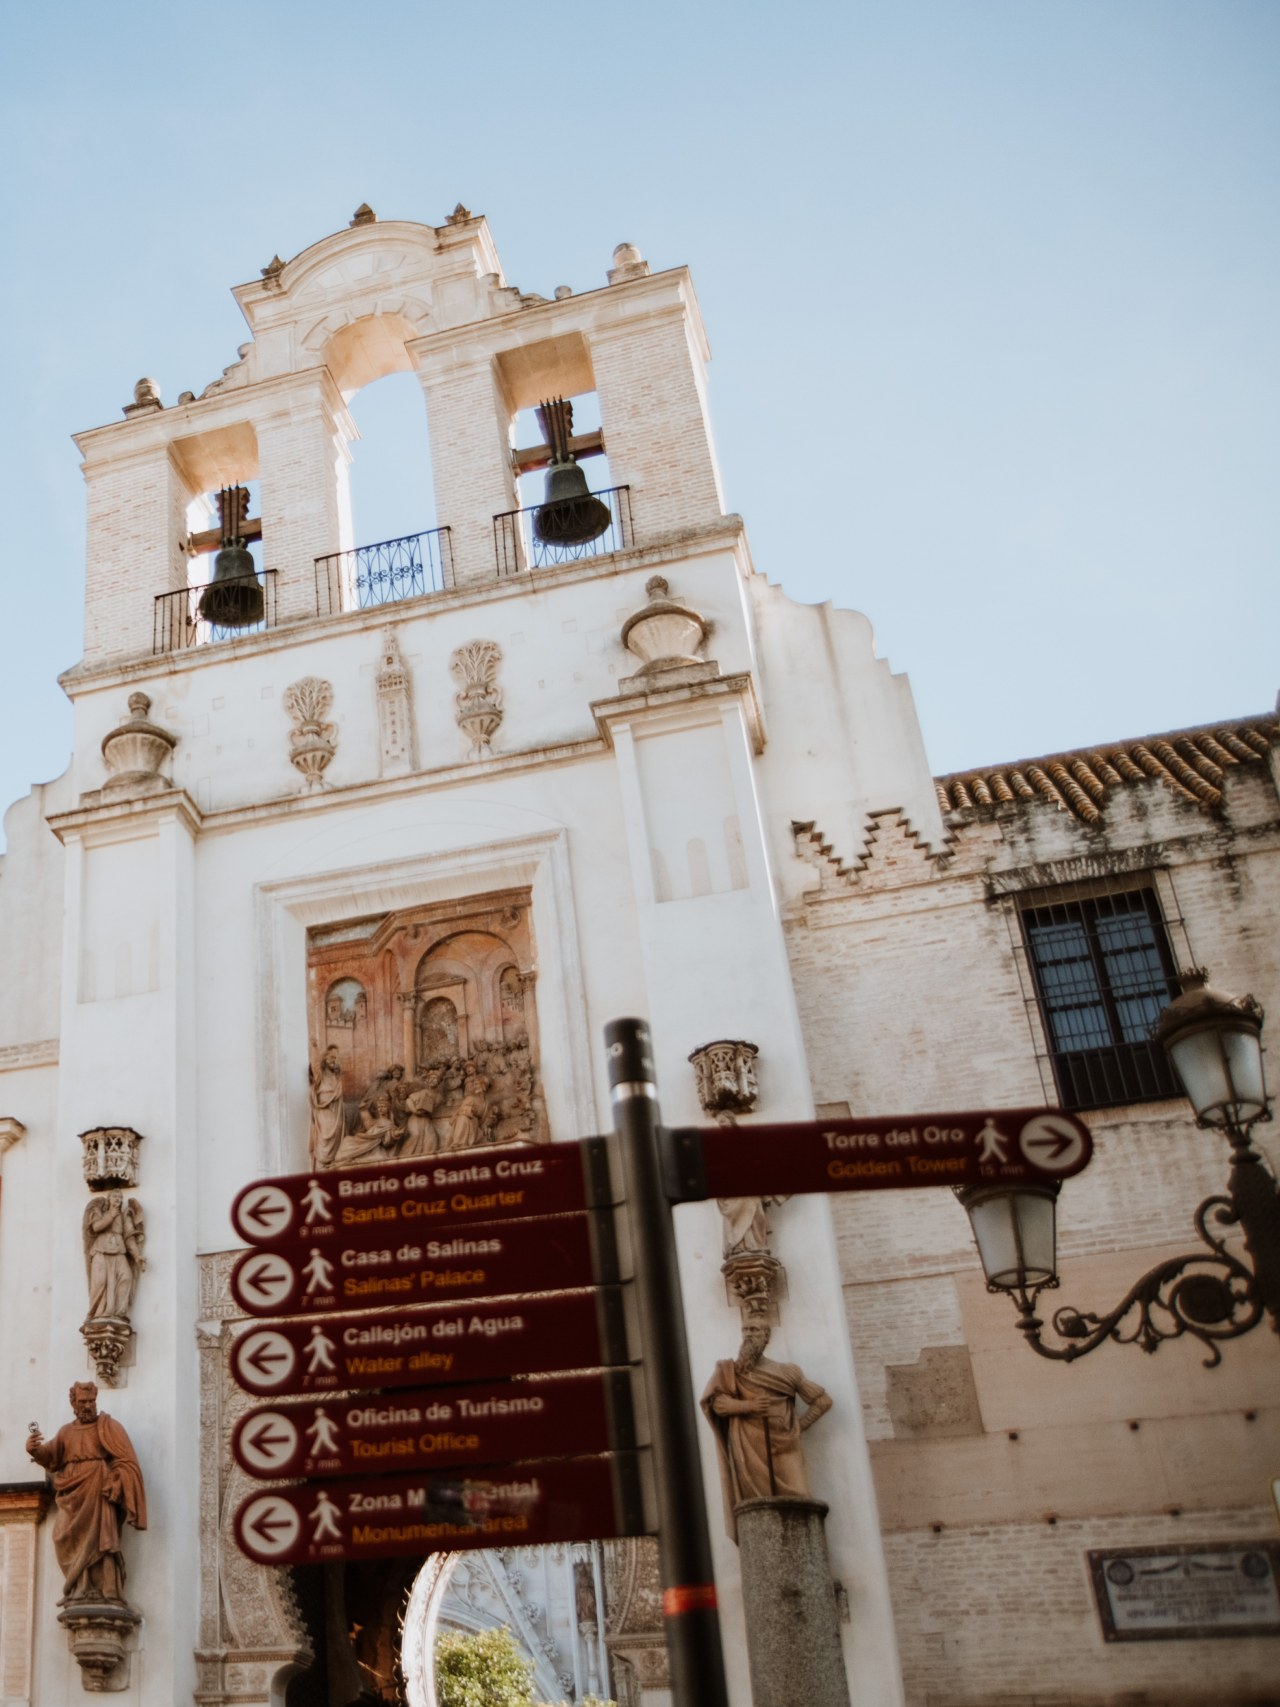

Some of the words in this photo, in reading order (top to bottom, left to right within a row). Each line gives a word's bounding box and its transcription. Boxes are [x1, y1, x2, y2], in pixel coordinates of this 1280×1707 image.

[824, 1130, 879, 1149] Torre
[885, 1127, 918, 1146] del
[923, 1126, 964, 1143] Oro
[827, 1159, 901, 1178] Golden
[906, 1155, 968, 1172] Tower
[1000, 1164, 1024, 1175] min
[338, 1174, 399, 1197] Barrio
[403, 1169, 428, 1188] de
[433, 1164, 491, 1185] Santa
[496, 1160, 543, 1178] Cruz
[342, 1204, 397, 1224] Santa
[401, 1198, 447, 1216] Cruz
[451, 1190, 524, 1211] Quarter
[313, 1224, 334, 1235] min
[341, 1250, 391, 1267] Casa
[397, 1243, 420, 1261] de
[426, 1237, 502, 1259] Salinas
[421, 1268, 485, 1288] Palace
[313, 1294, 336, 1306] min
[343, 1323, 427, 1346] Callejón
[432, 1319, 463, 1338] del
[469, 1314, 524, 1336] Agua
[346, 1355, 402, 1374] Water
[409, 1352, 454, 1371] alley
[315, 1375, 338, 1386] min
[347, 1407, 420, 1428] Oficina
[426, 1402, 451, 1420] de
[457, 1396, 544, 1417] Turismo
[351, 1437, 415, 1458] Tourist
[420, 1432, 480, 1452] Office
[318, 1458, 342, 1470] min
[349, 1492, 401, 1511] Zona
[481, 1513, 529, 1533] area
